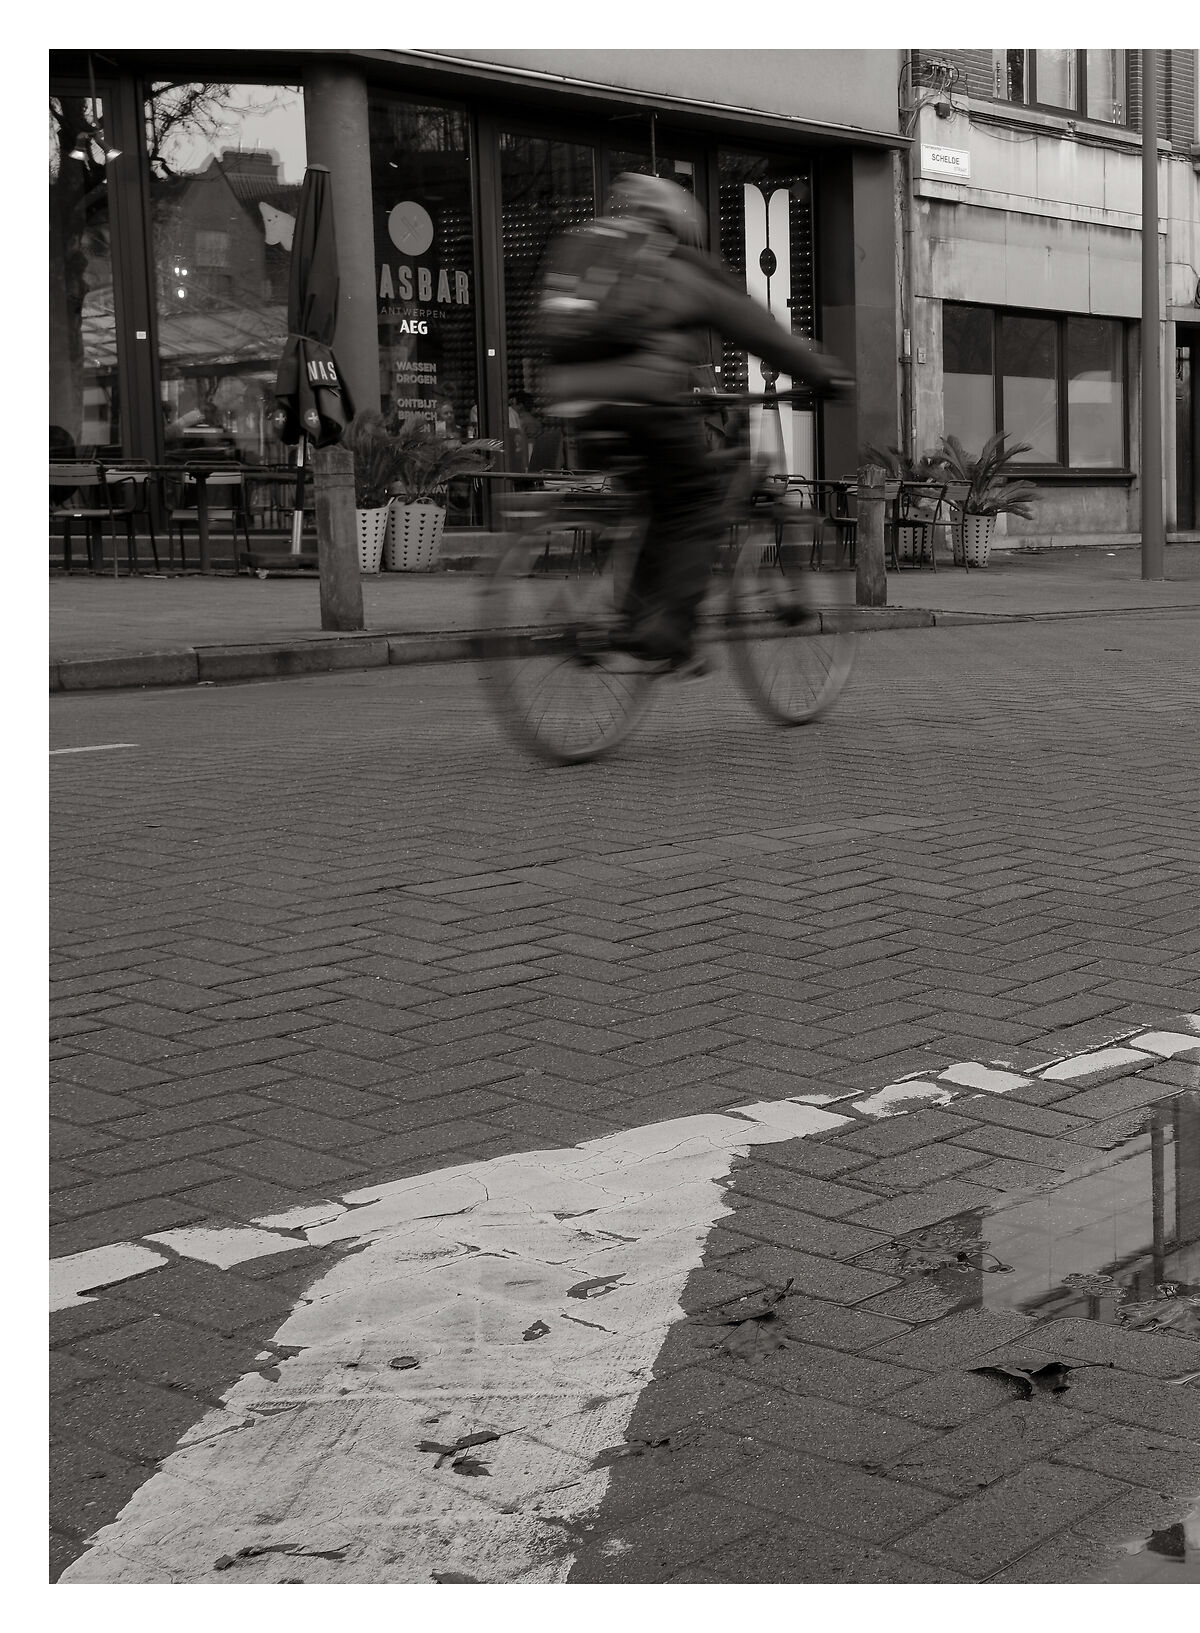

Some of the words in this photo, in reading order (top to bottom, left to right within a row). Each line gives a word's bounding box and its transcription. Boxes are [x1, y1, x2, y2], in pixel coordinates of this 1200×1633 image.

[931, 153, 960, 166] SCHELDE
[379, 263, 469, 304] ASBAR
[381, 306, 446, 319] ANTWERPEN
[400, 319, 428, 335] AEG
[396, 361, 437, 373] WASSEN
[396, 374, 437, 385] DROGEN
